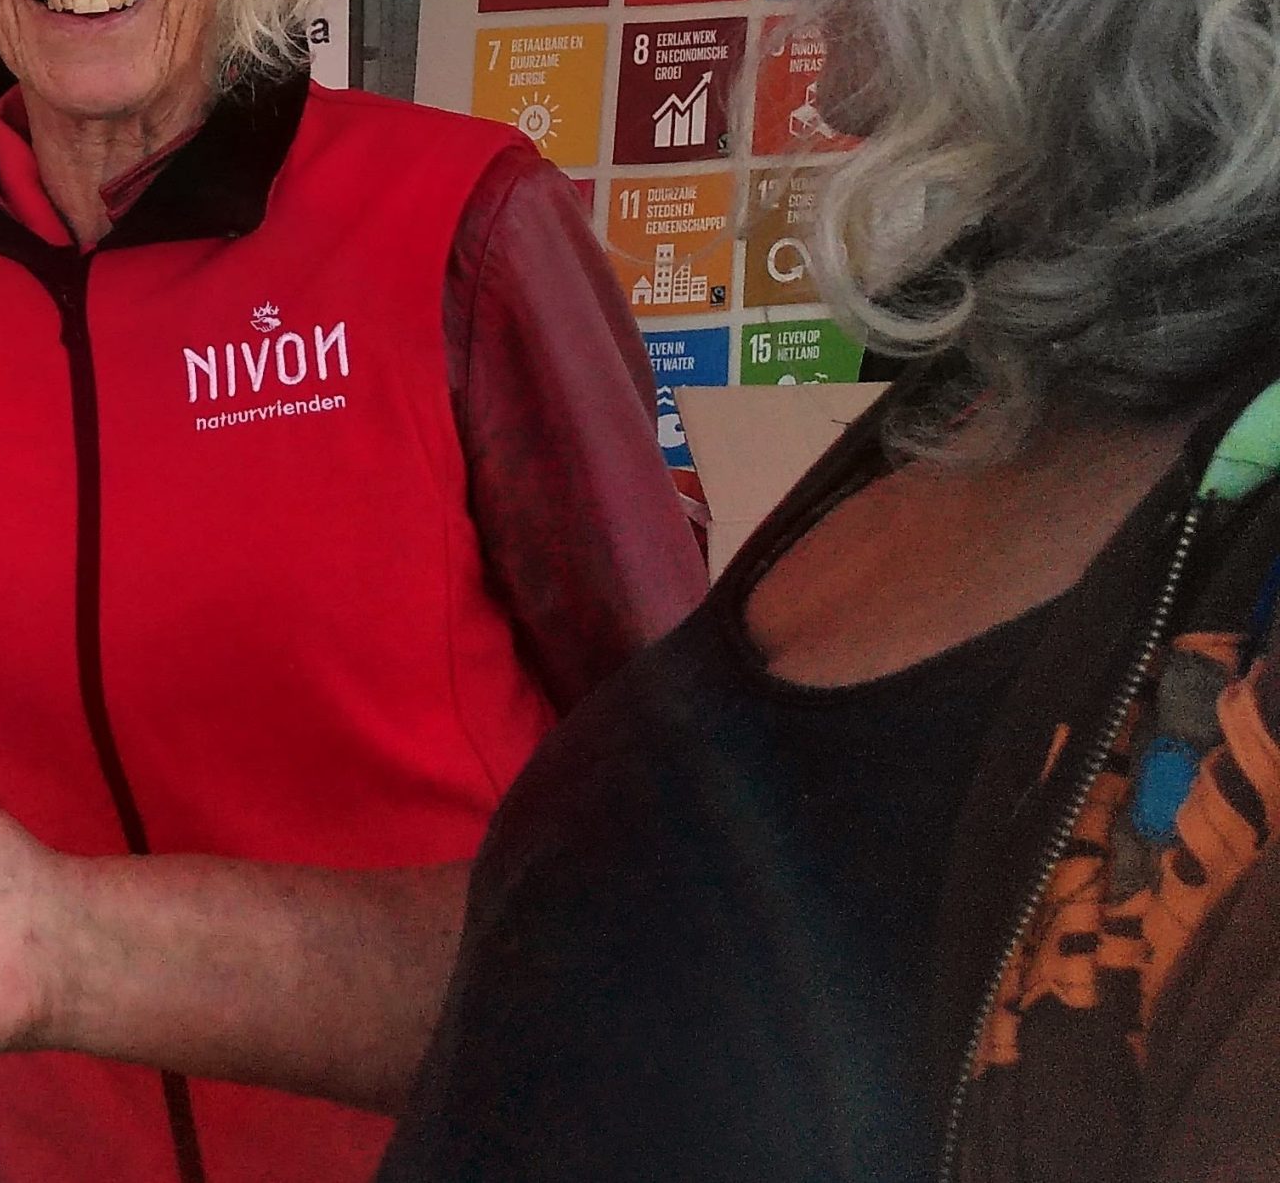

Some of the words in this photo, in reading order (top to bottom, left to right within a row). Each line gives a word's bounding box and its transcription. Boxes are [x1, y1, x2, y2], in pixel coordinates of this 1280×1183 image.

[510, 36, 570, 54] BETAALBARE
[570, 35, 584, 51] EN
[656, 30, 692, 48] EERLIJK
[692, 28, 718, 46] WERK
[487, 39, 502, 71] 7
[633, 34, 649, 65] 8
[655, 48, 668, 64] EN
[668, 44, 729, 64] ECONOMISCHE
[509, 53, 560, 70] DUURZAME
[508, 69, 547, 87] ENERGIE
[654, 63, 682, 81] GROEI
[647, 185, 698, 202] DUURZAME
[619, 189, 641, 220] 11
[646, 203, 682, 219] STEDEN
[682, 202, 695, 216] EN
[778, 330, 807, 346] LEVEN
[807, 329, 821, 343] OP
[674, 340, 685, 356] IN
[749, 333, 772, 364] 15
[777, 346, 795, 362] HET
[795, 345, 820, 360] LAND
[182, 320, 350, 403] NIVON
[662, 356, 695, 371] WATER
[195, 393, 347, 432] natuurvrienden
